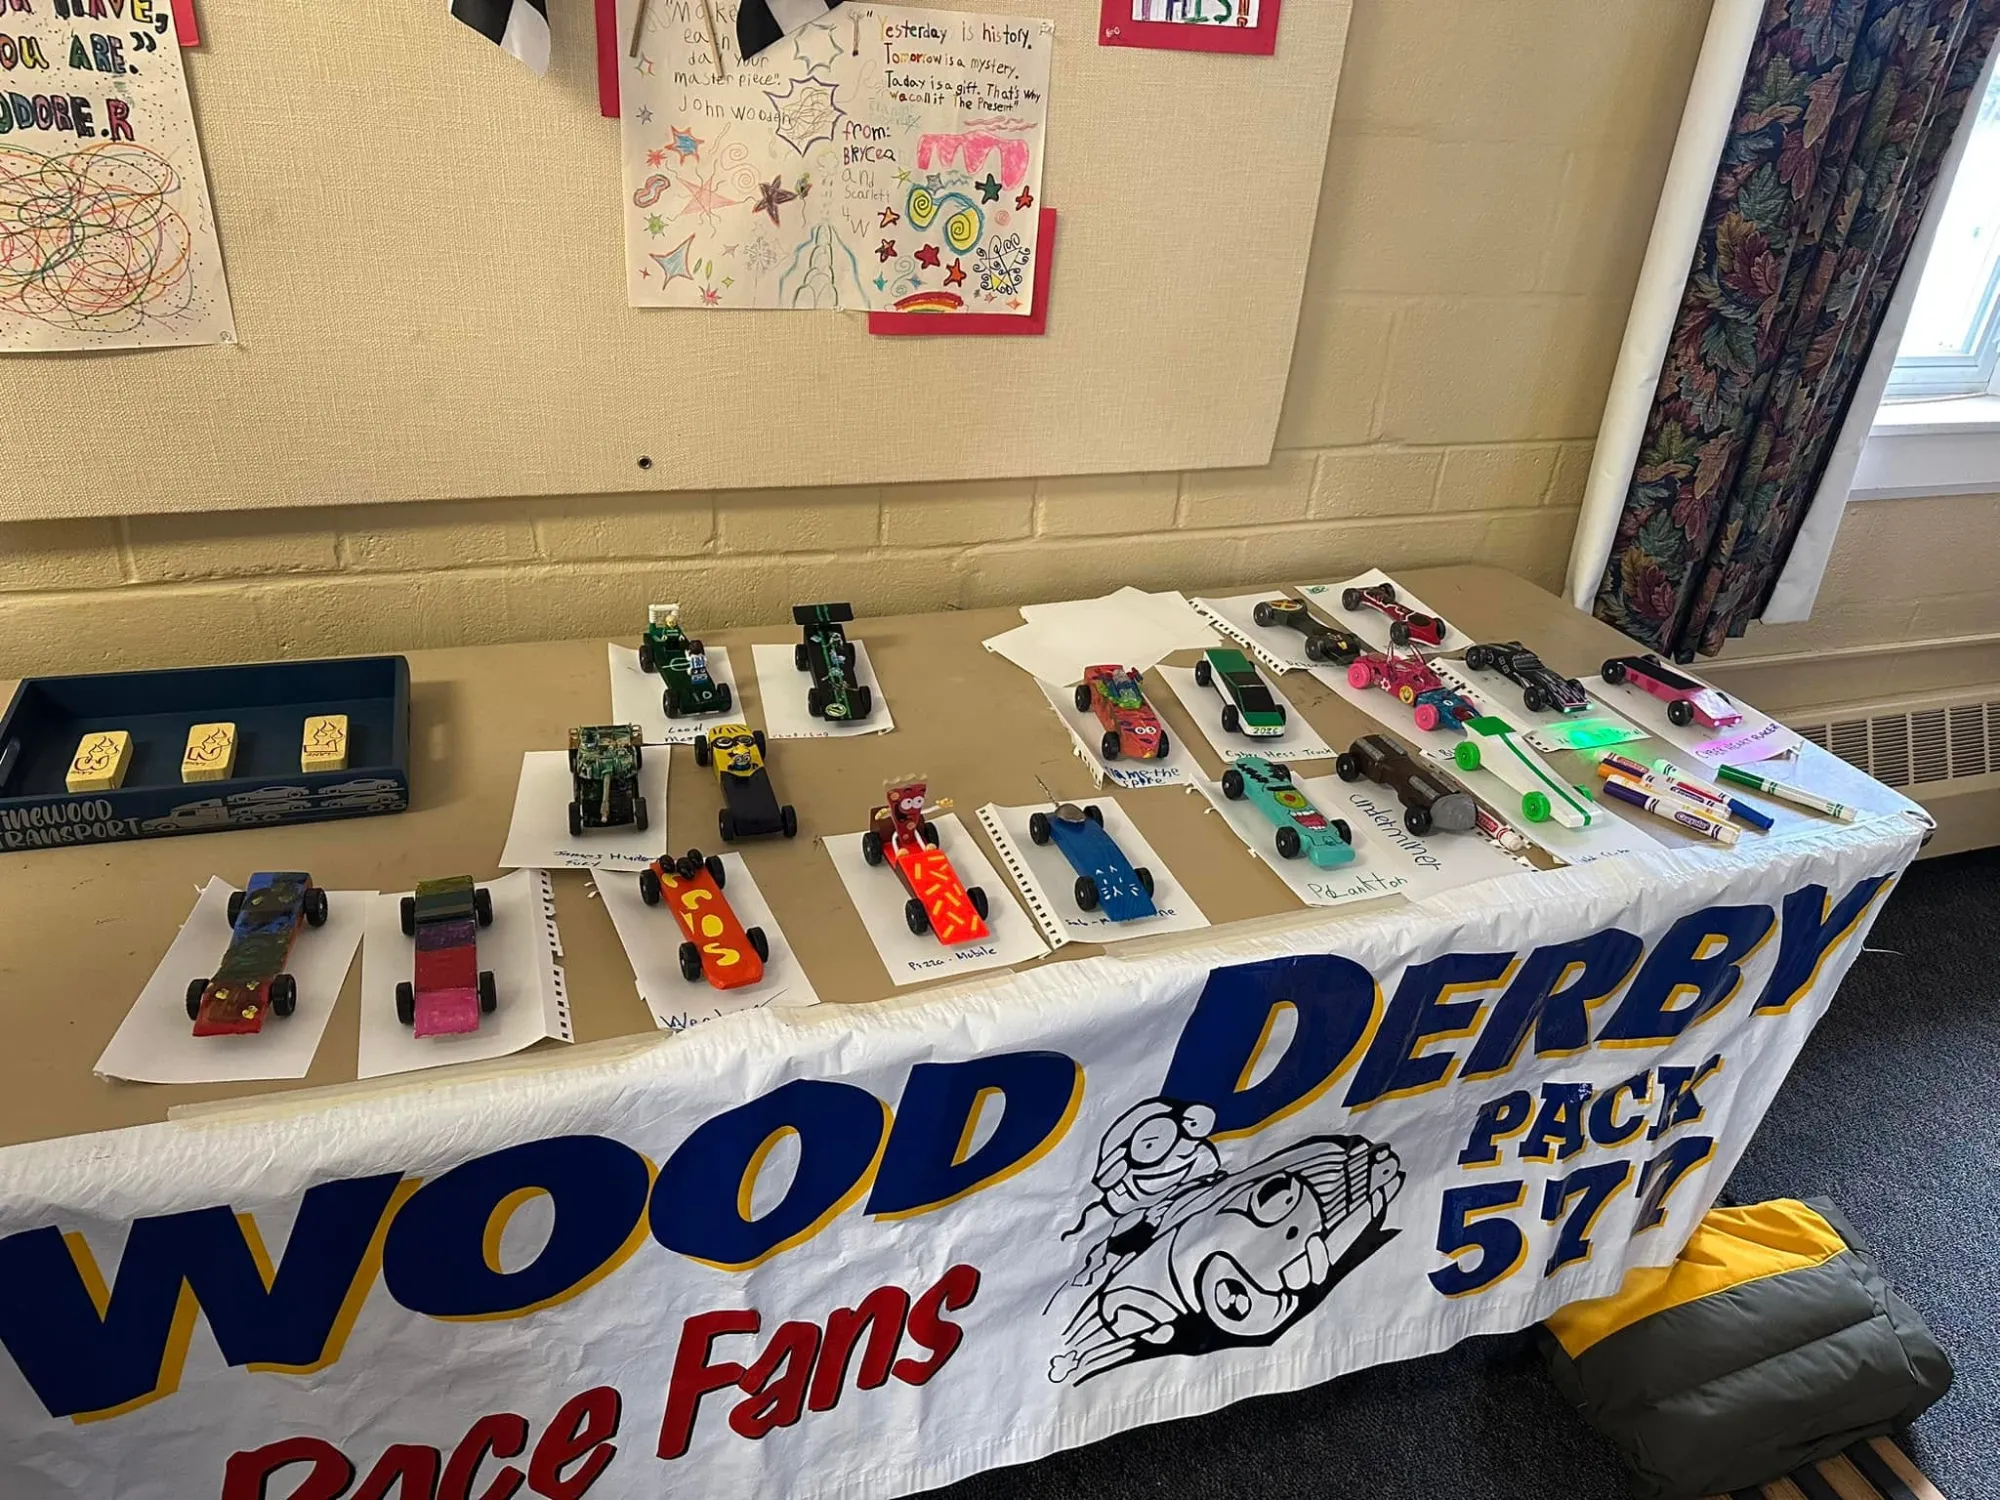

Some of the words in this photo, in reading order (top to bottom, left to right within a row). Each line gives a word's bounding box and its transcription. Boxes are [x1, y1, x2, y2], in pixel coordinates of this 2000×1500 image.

[684, 28, 730, 50] eah
[962, 22, 974, 42] is
[982, 22, 1032, 49] history.
[971, 58, 1019, 80] mystery.
[678, 94, 725, 118] John
[842, 120, 891, 141] from:
[842, 168, 875, 188] and
[0, 818, 140, 850] RANSPORT
[1457, 1053, 1723, 1167] PACK
[0, 1051, 1086, 1424] WOOD
[1160, 870, 1896, 1140] DERBY
[1428, 1134, 1716, 1300] 577
[656, 1264, 981, 1460] Fans
